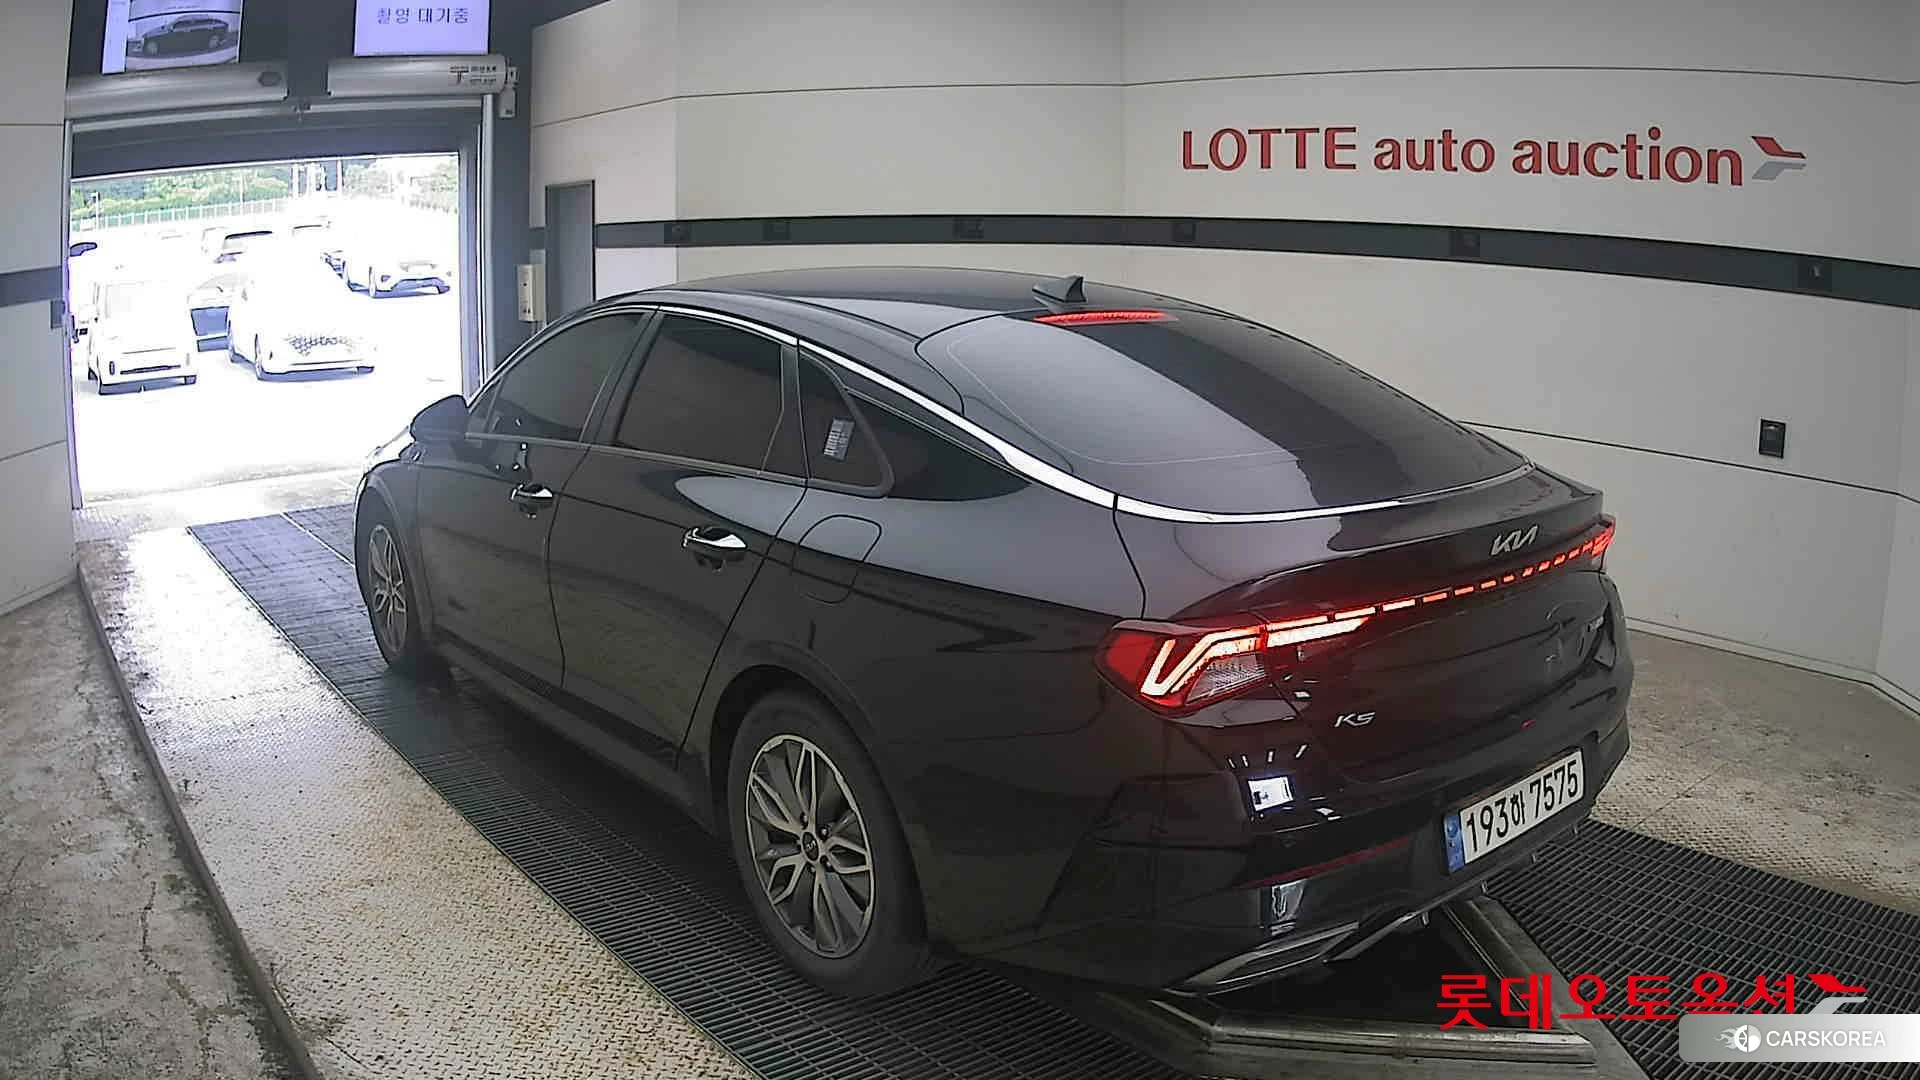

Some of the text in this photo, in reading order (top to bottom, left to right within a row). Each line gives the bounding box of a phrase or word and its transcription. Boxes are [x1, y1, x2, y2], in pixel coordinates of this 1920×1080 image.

[418, 7, 469, 24] 대기중
[1182, 126, 1743, 186] LOTTE auto auction
[1334, 712, 1376, 728] K5
[1466, 759, 1578, 852] 193하 7575
